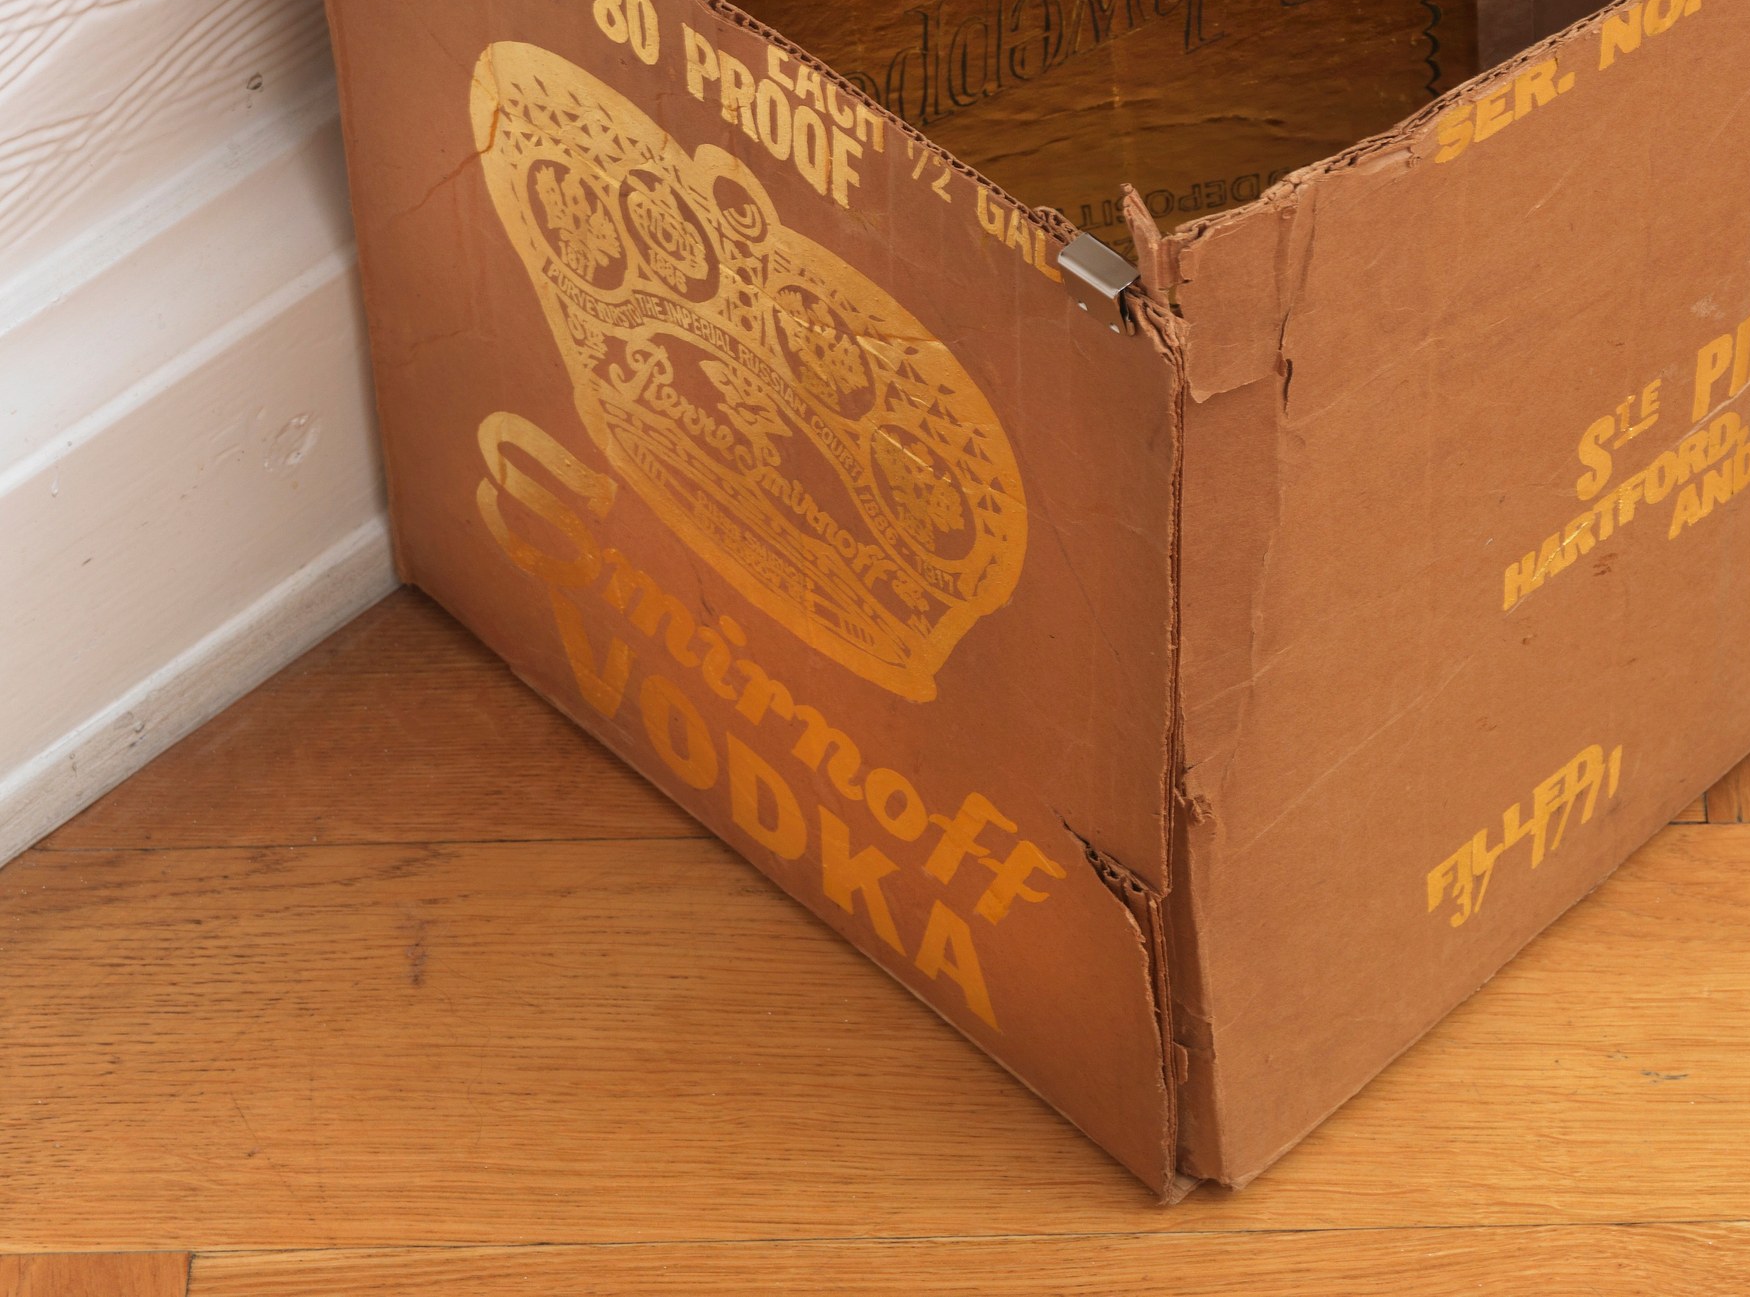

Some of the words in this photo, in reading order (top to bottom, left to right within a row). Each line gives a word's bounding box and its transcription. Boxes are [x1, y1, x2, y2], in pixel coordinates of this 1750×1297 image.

[682, 23, 865, 209] PROOF
[1434, 57, 1575, 164] SER.
[548, 262, 630, 327] PURVEYORS
[635, 293, 663, 321] THE
[664, 301, 736, 357] IMPERIAL
[738, 344, 806, 417] RUSSIAN
[811, 415, 864, 479] COURT
[859, 491, 897, 545] 1886
[915, 556, 954, 589] 1917
[609, 336, 735, 458] Pierre
[733, 445, 900, 592] Smirnoff
[1504, 411, 1750, 611] HARTFORD,
[477, 411, 1066, 925] Smirnoff
[549, 584, 1002, 1033] VODKA
